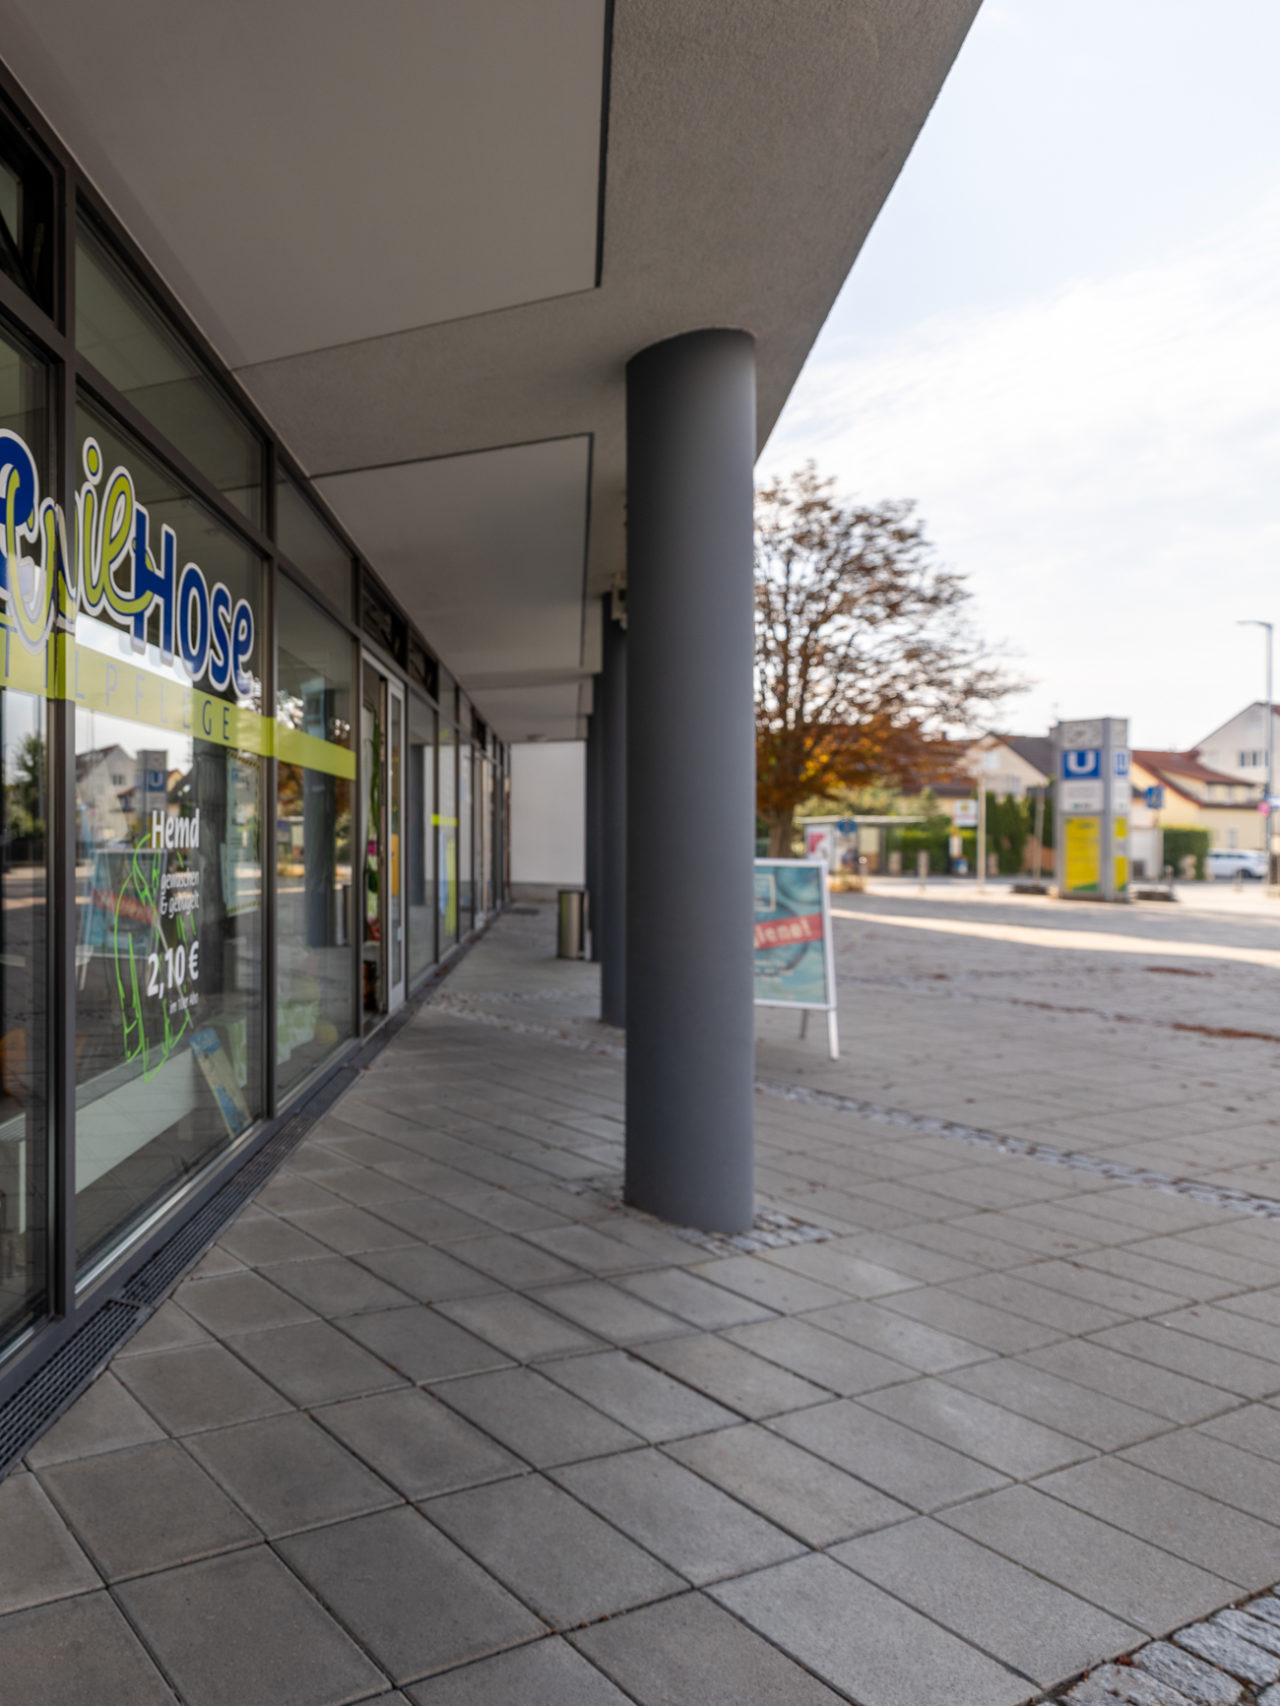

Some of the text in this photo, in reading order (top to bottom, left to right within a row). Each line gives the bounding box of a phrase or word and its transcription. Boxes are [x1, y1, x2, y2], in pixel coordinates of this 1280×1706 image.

[5, 437, 155, 655] wie
[130, 500, 254, 699] Hose
[1067, 751, 1095, 774] U
[151, 808, 200, 849] Hemd
[147, 940, 200, 1000] 2,10 €
